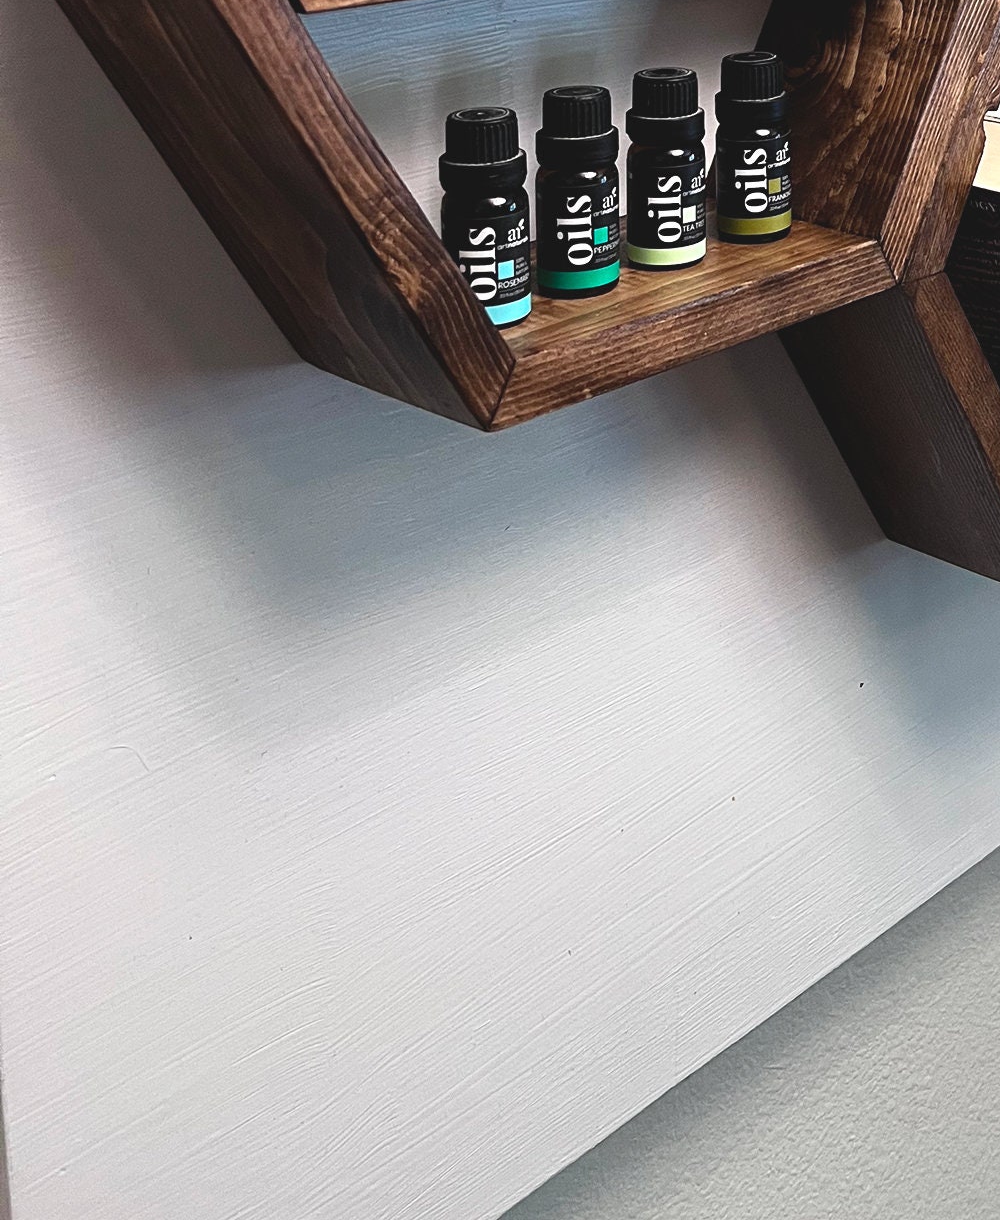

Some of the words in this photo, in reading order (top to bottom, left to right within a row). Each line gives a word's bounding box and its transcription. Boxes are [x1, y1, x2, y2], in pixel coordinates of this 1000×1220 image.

[647, 175, 682, 243] oils
[734, 148, 768, 213] oils
[556, 195, 593, 266] oils
[683, 223, 695, 232] TEA
[459, 227, 497, 301] oils
